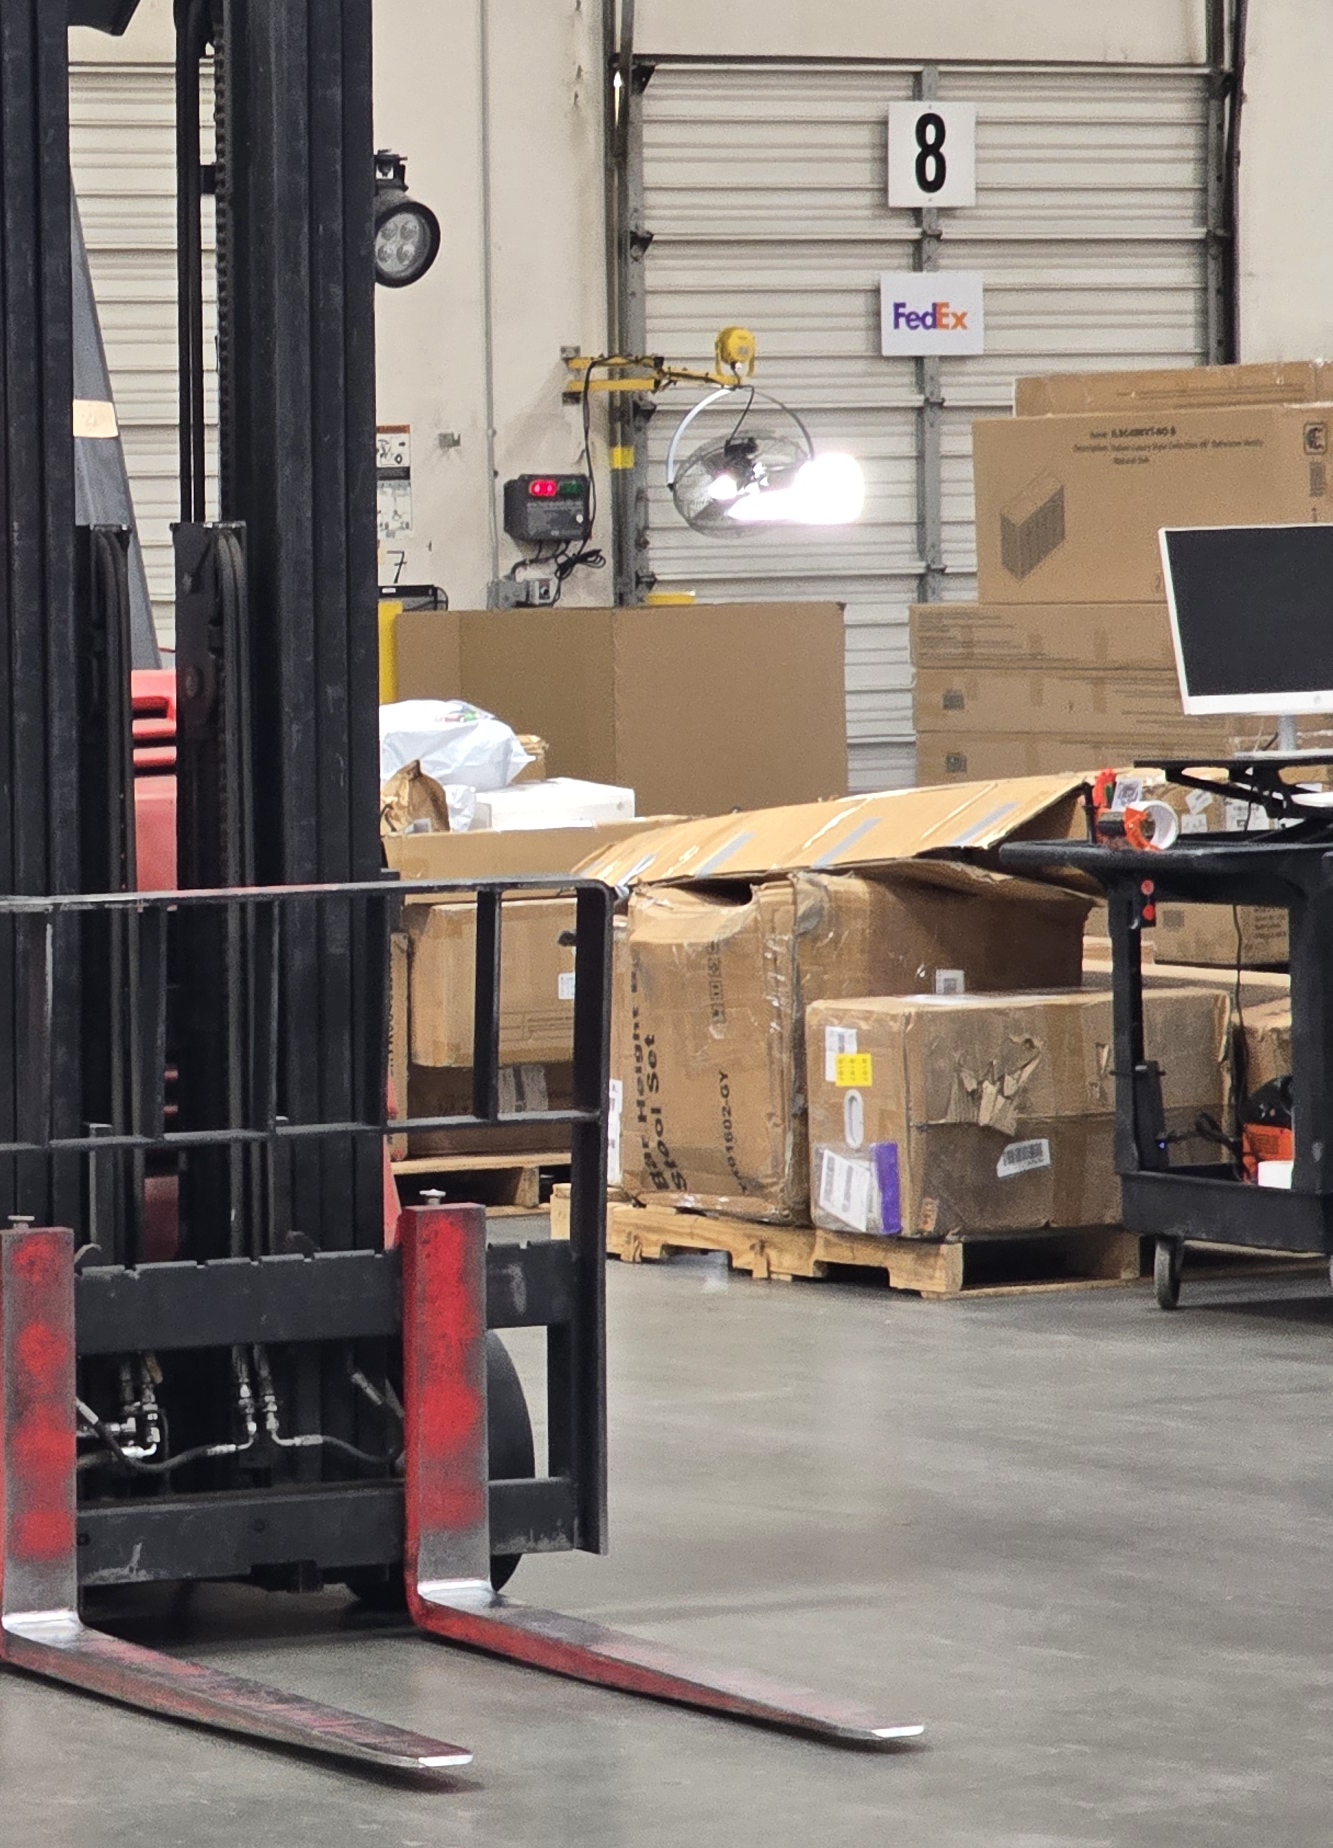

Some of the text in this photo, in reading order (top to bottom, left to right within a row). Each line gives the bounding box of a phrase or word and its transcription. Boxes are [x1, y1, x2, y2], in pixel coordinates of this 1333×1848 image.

[914, 112, 947, 194] 8
[892, 301, 969, 332] FedEx
[386, 550, 408, 584] 7
[632, 1006, 670, 1190] Bar Height
[645, 1034, 687, 1191] Stool Set
